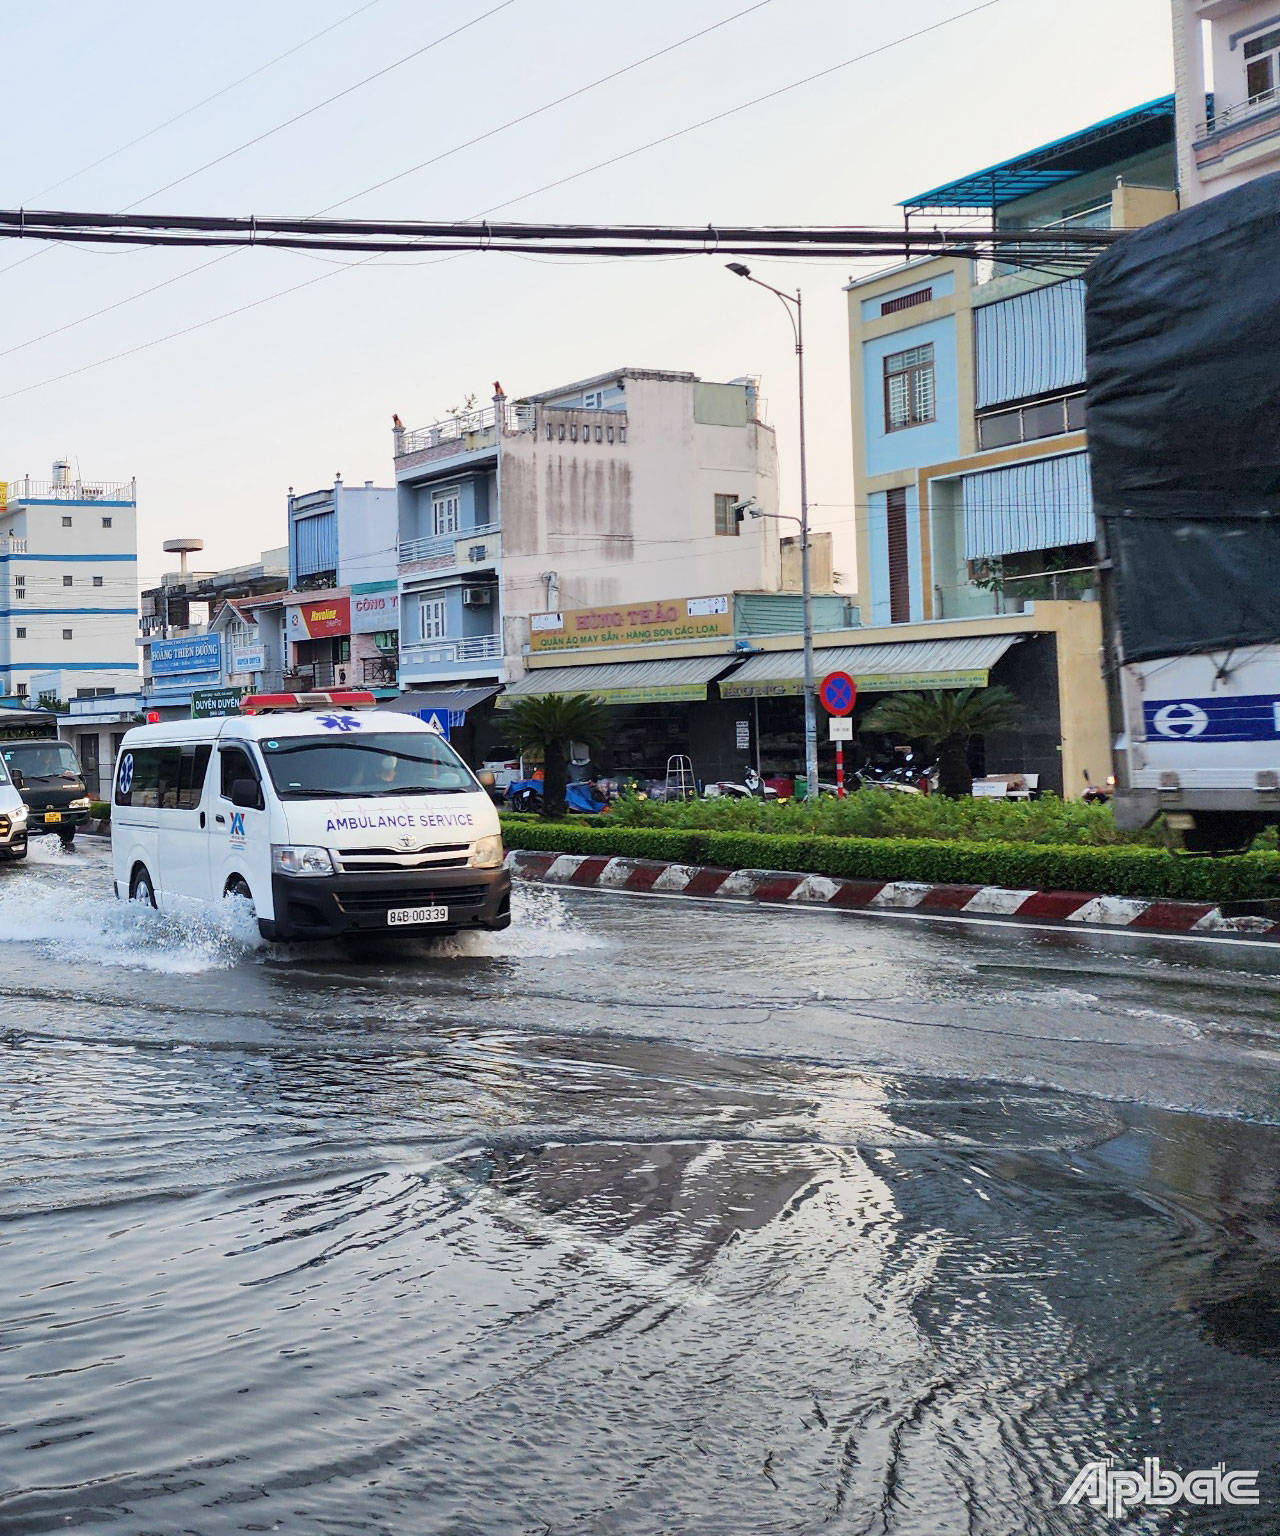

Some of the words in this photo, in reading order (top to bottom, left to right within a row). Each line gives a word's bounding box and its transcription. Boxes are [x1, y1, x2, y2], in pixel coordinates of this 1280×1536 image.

[311, 608, 337, 622] Havoline
[195, 698, 217, 710] DUYÊN
[218, 696, 240, 708] DUYÊN
[326, 815, 416, 832] AMBULANCE
[420, 814, 474, 827] SERVICE
